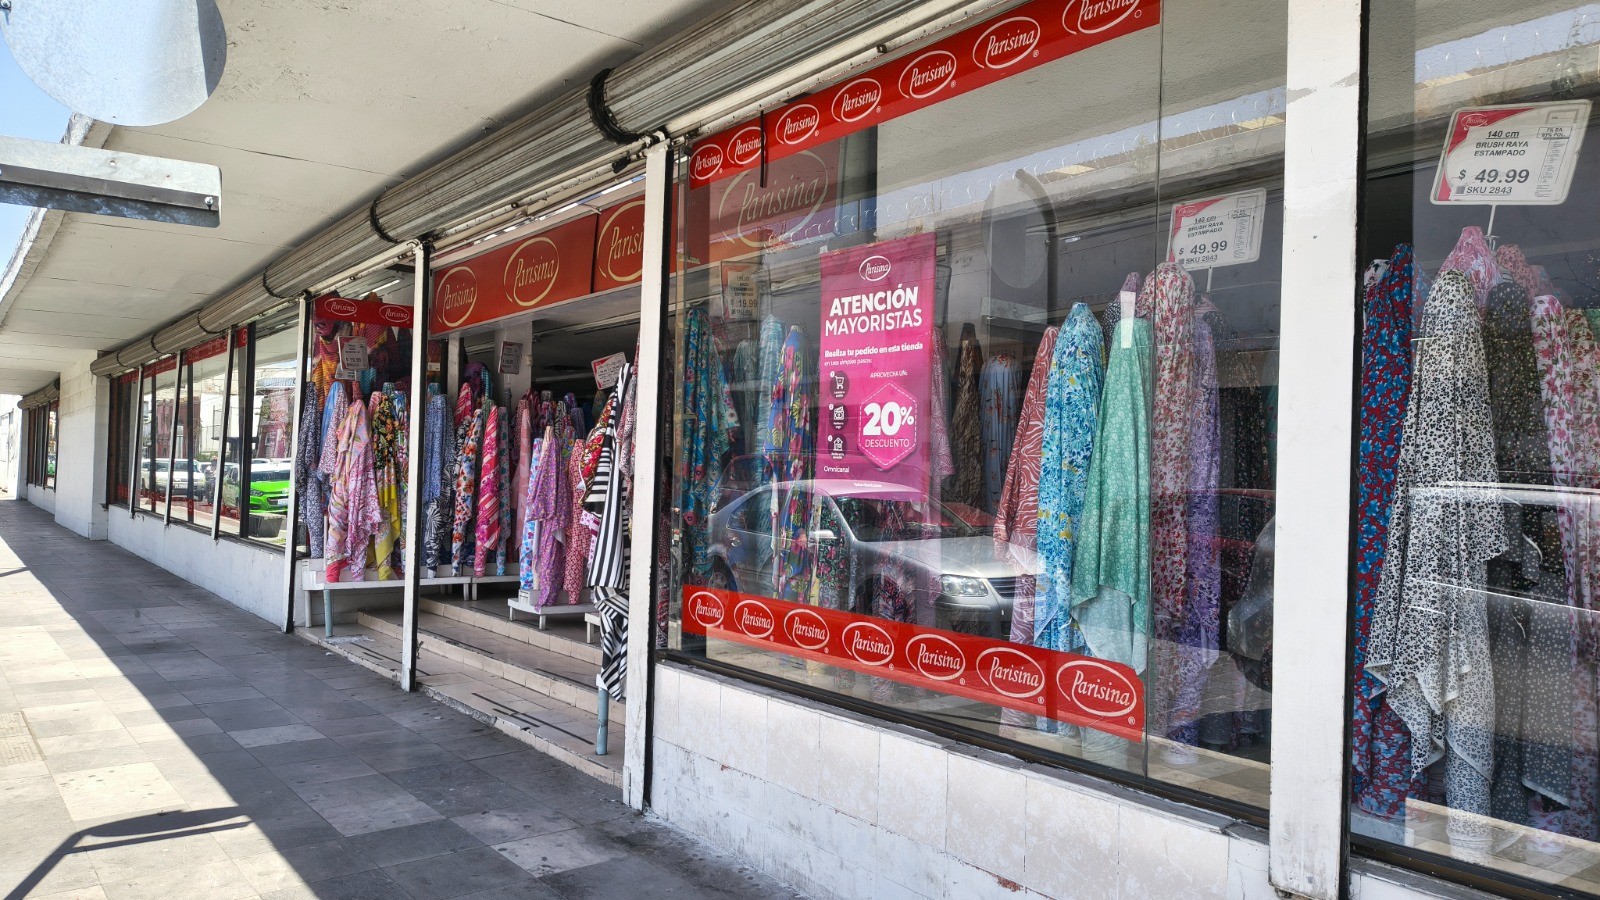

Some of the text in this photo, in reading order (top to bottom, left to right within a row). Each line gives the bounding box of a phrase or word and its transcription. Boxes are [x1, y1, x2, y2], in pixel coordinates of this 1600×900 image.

[988, 29, 1035, 57] Parisina
[912, 59, 953, 88] Parisina
[842, 88, 877, 112] Parisina
[785, 114, 816, 135] Parisina
[1487, 130, 1503, 138] 140
[1474, 149, 1525, 157] ESTAMPADO
[1475, 140, 1529, 149] BRUSH RAYA
[695, 153, 721, 171] Parisina
[1458, 168, 1530, 184] $ 49.99
[741, 174, 819, 222] Parisina
[1466, 186, 1513, 194] SKU 2843
[611, 222, 644, 260] Parisi
[1190, 240, 1228, 255] 49.99
[516, 256, 555, 287] Parisina
[866, 262, 889, 275] Parisina
[332, 301, 355, 312] Parisina
[444, 283, 474, 310] Parisina
[829, 283, 919, 317] ATENCIÓN
[386, 308, 408, 319] Parisina
[825, 308, 922, 337] MAYORISTAS
[824, 350, 846, 358] Realiza
[855, 346, 878, 357] pedido
[879, 346, 887, 354] en
[888, 345, 900, 353] esta
[901, 341, 923, 352] tienda
[870, 370, 899, 379] APROVECHA
[862, 401, 914, 436] 20%
[864, 438, 910, 448] DESCUENTO
[823, 465, 850, 473] Omnicanal
[697, 598, 722, 619] Parisina
[742, 609, 771, 630] Parisina
[793, 616, 826, 641] Parisina
[853, 629, 890, 656] Parisina
[919, 642, 961, 670] Parisina
[991, 656, 1040, 687] Parisina
[1074, 669, 1130, 707] Parisina
